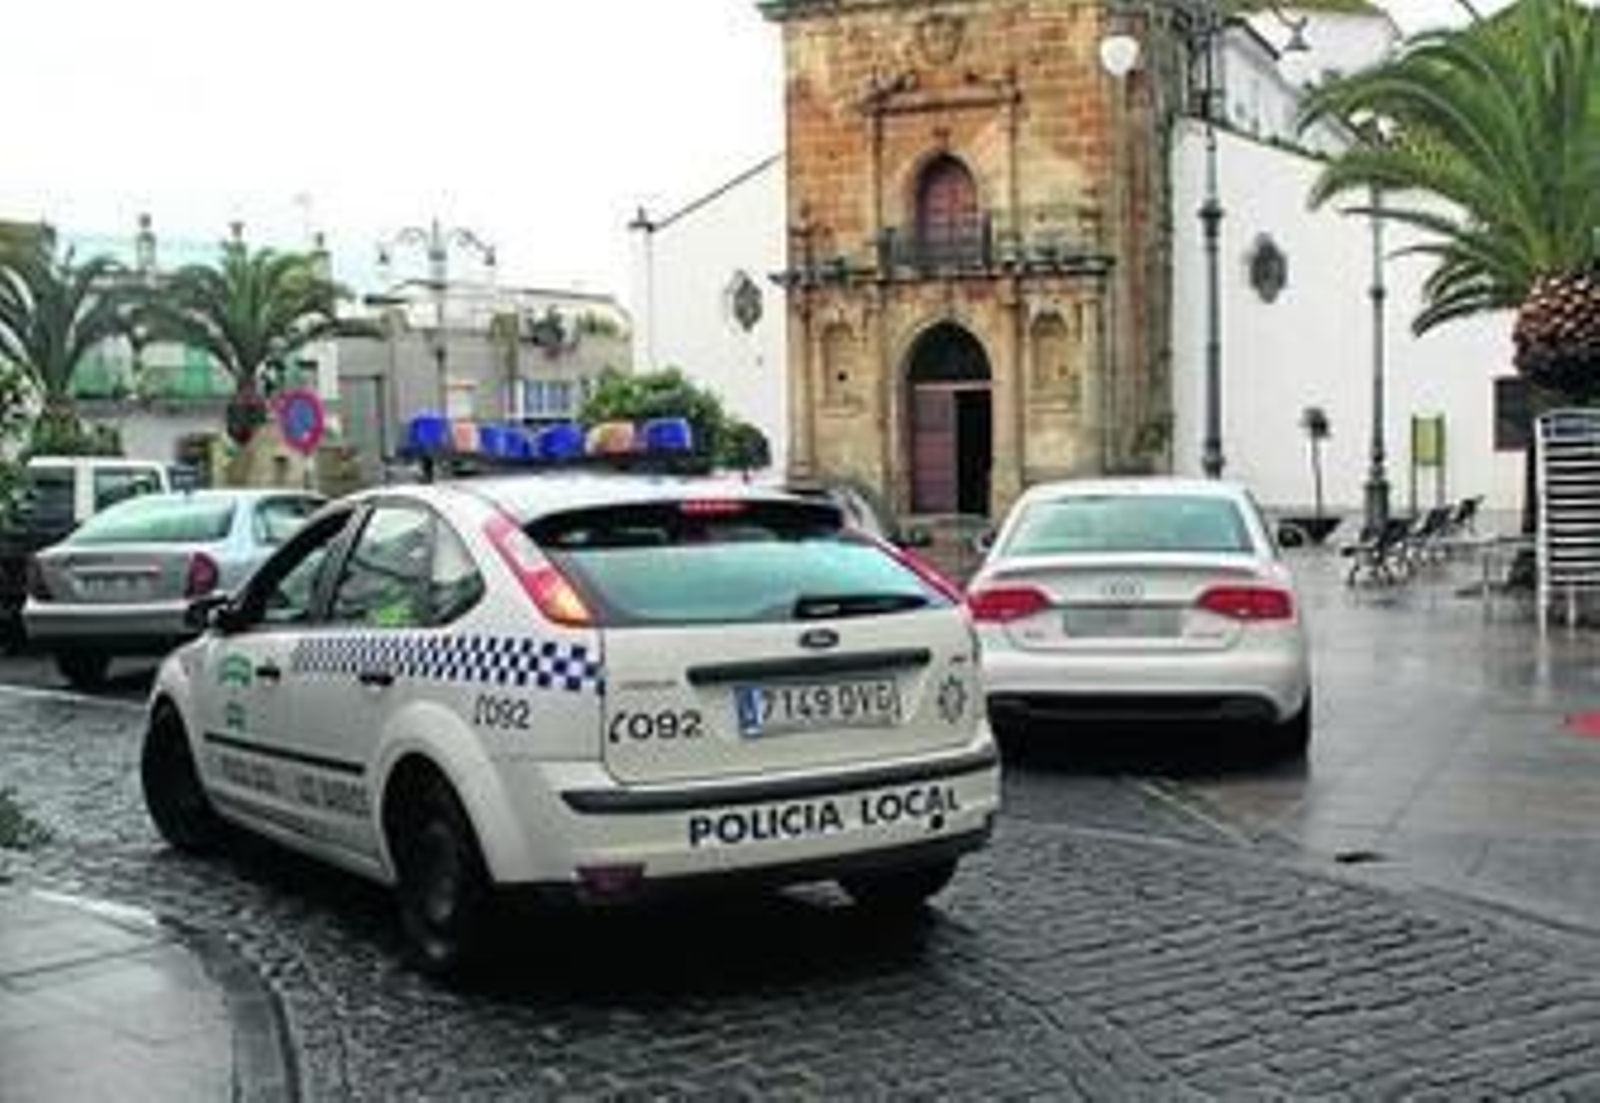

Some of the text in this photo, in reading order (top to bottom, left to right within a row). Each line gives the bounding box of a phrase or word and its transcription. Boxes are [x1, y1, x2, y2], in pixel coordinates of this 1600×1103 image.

[485, 695, 529, 730] 092
[628, 709, 703, 742] 092
[689, 785, 959, 846] POLICIA LOCAL
